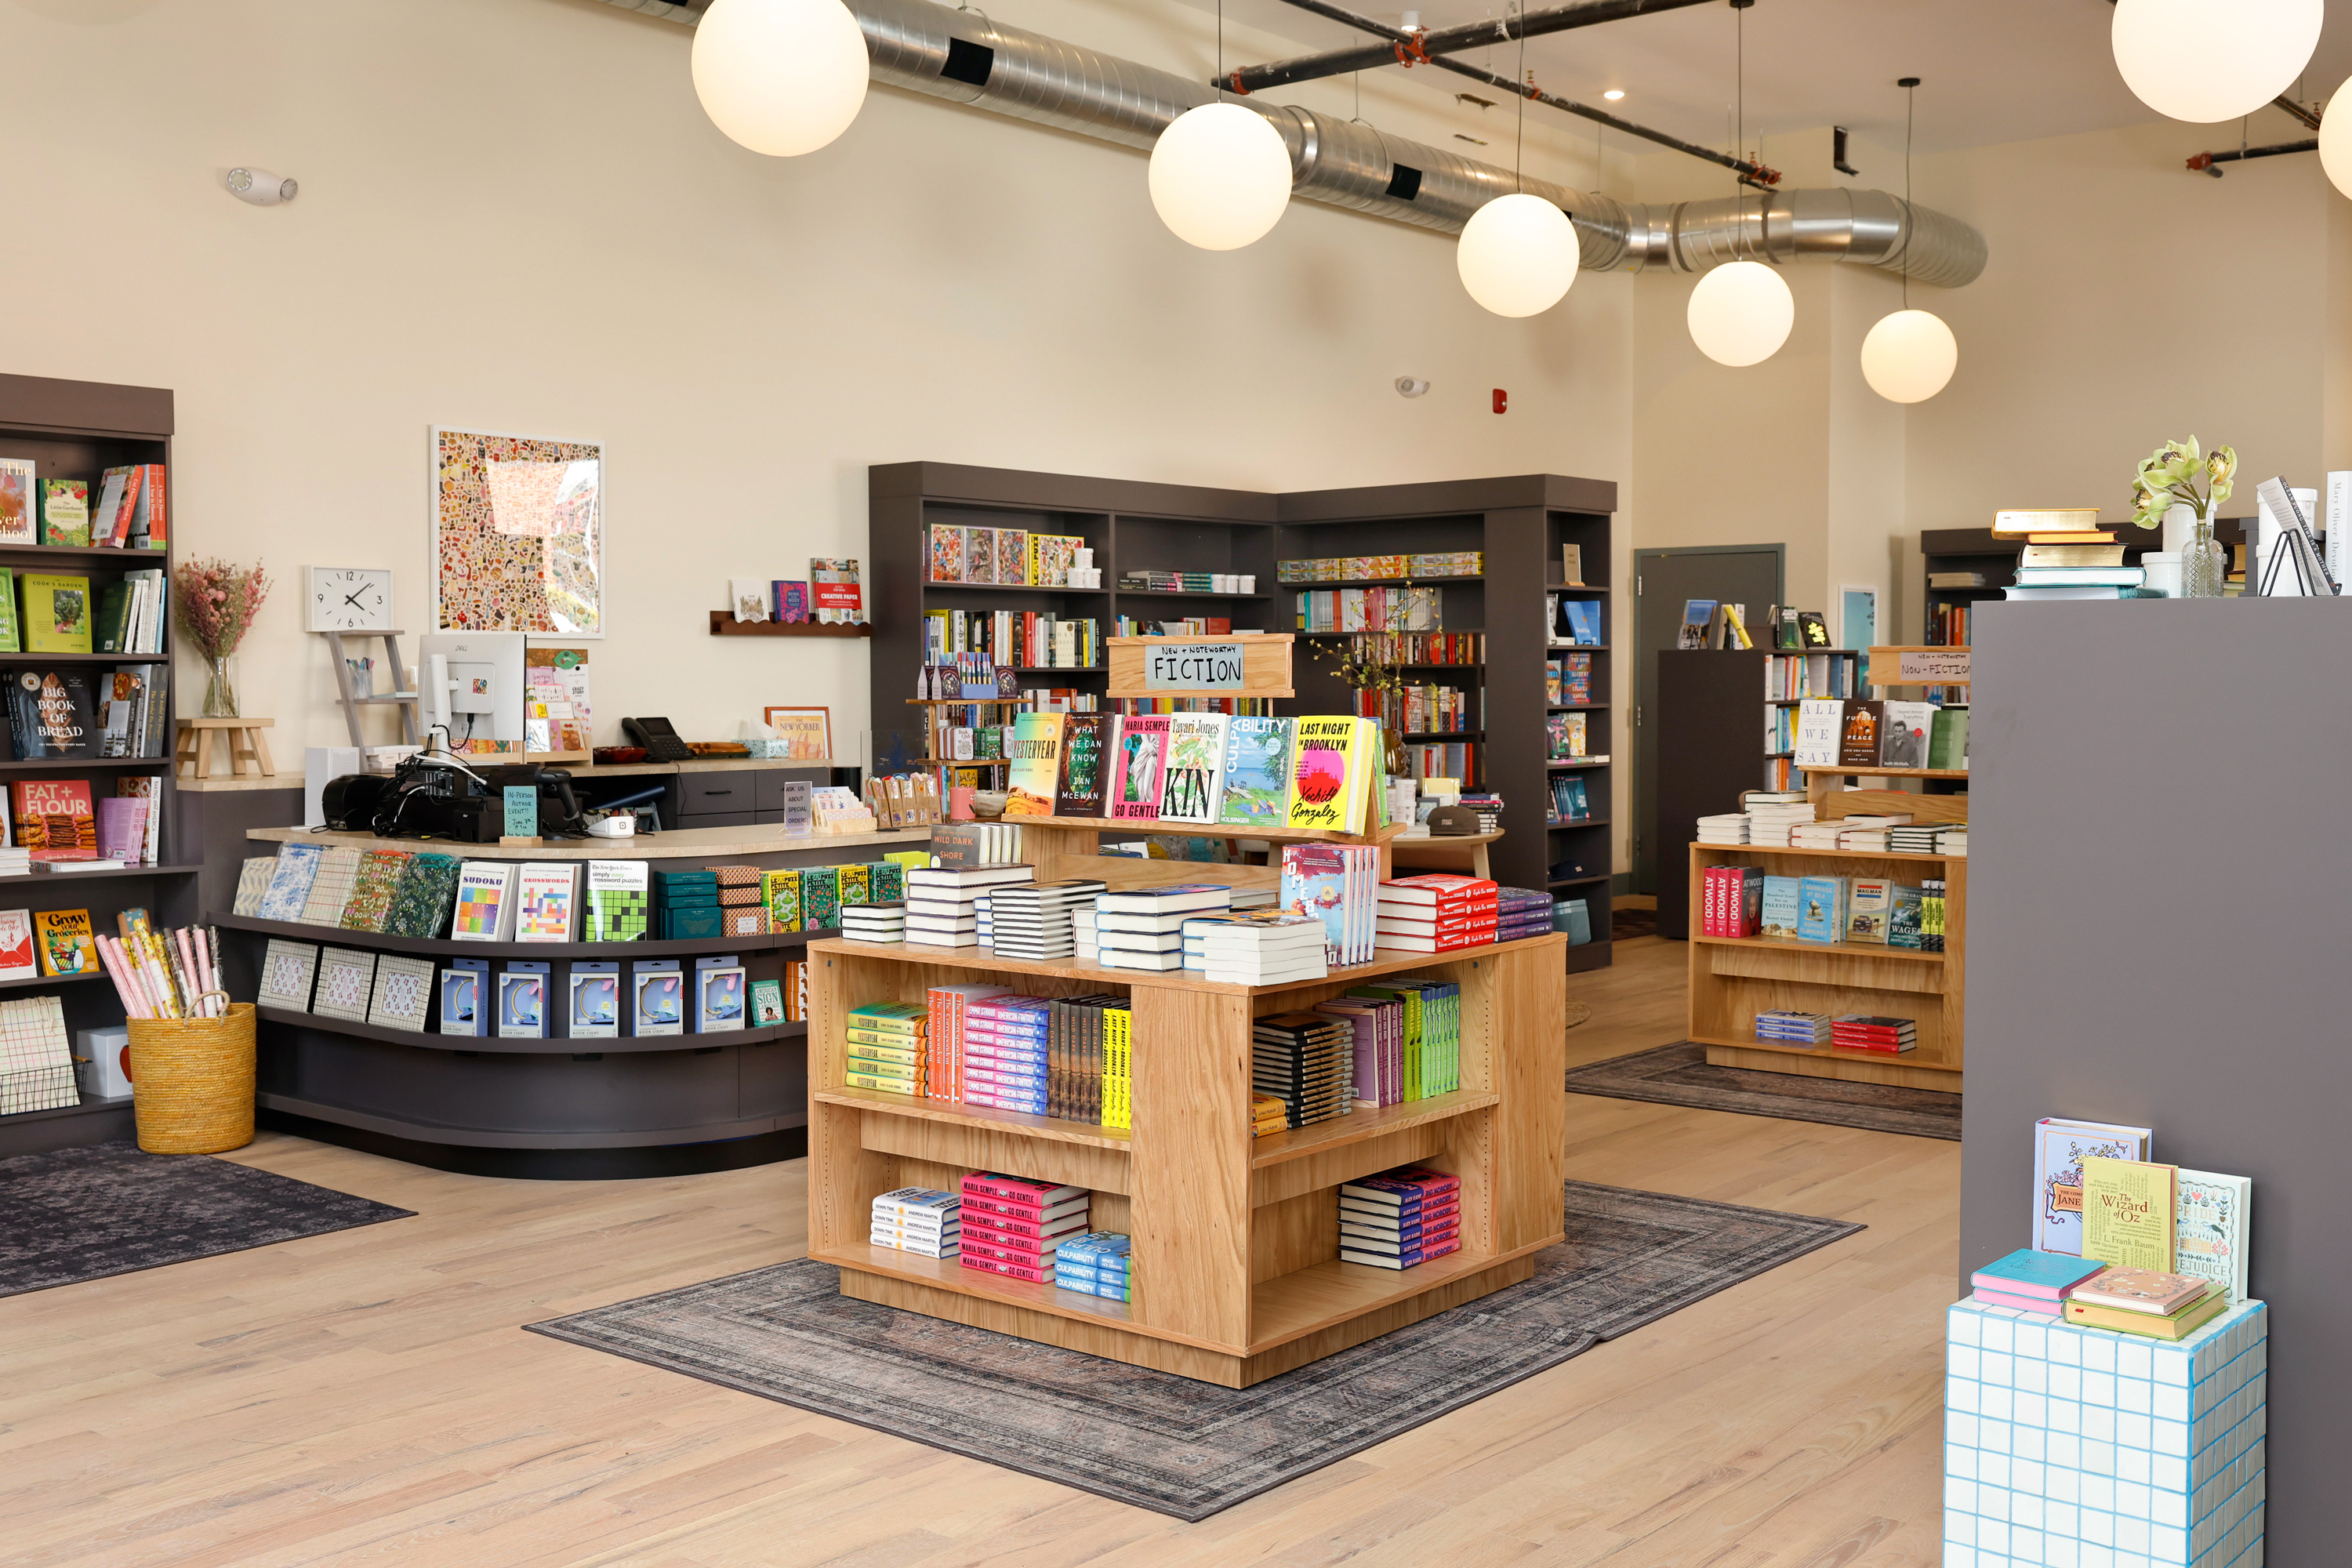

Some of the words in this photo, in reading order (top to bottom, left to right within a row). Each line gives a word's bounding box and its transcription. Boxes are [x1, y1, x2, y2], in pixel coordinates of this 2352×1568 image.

[3, 462, 31, 476] The
[2332, 482, 2341, 503] Mary
[2282, 481, 2296, 503] OCEAN
[2292, 502, 2304, 521] VUONG
[2303, 524, 2311, 539] TIME
[2316, 552, 2328, 576] MOTHER
[347, 572, 354, 581] 12
[1034, 574, 1038, 586] LE
[318, 593, 324, 603] 9
[376, 596, 383, 604] 3
[348, 618, 354, 627] 6
[1189, 645, 1236, 654] NOTEWORTHY
[1155, 658, 1241, 682] FICTION
[44, 688, 67, 697] BIG
[473, 686, 488, 695] MORE
[38, 700, 75, 710] BOOK
[1802, 704, 1836, 715] ALL
[50, 713, 67, 723] OF
[38, 726, 83, 737] BREAD
[1125, 721, 1143, 731] MARIA
[1145, 721, 1170, 731] SEMPLE
[1172, 719, 1195, 734] Tayari
[1196, 720, 1219, 735] Jones
[1300, 724, 1319, 735] LAST
[1321, 724, 1350, 735] NIGHT
[1805, 728, 1828, 740] WE
[1013, 740, 1056, 759] YESTERYEAR
[1303, 739, 1347, 750] BROOKLYN
[1797, 752, 1831, 763] SAY
[25, 784, 58, 800] FAT
[1062, 791, 1098, 800] McEWAN
[1161, 768, 1214, 818] KIN
[1298, 785, 1338, 803] Xochitl
[27, 800, 89, 815] FLOUR
[1115, 804, 1125, 817] GO
[1129, 804, 1160, 818] GENTLE
[1291, 803, 1341, 825] Gonzalez
[953, 837, 973, 845] DARK
[940, 851, 963, 860] SHORE
[463, 877, 503, 886] SUDOKU
[1806, 884, 1832, 893] MARRIAGE
[1717, 877, 1726, 919] ATWOOD
[48, 913, 86, 927] Grow
[47, 929, 89, 938] Groceries
[757, 993, 779, 1004] SIGN
[964, 1181, 978, 1192] MARIA
[980, 1185, 997, 1196] SEMPLE
[1016, 1192, 1033, 1203] GENTLE
[2058, 1195, 2081, 1206] JANE
[2101, 1194, 2148, 1213] Wizard
[2114, 1210, 2121, 1219] of
[2122, 1210, 2140, 1223] Oz
[2112, 1236, 2132, 1246] Frank
[2134, 1240, 2155, 1250] Baum
[1058, 1279, 1094, 1293] CULPABILITY
